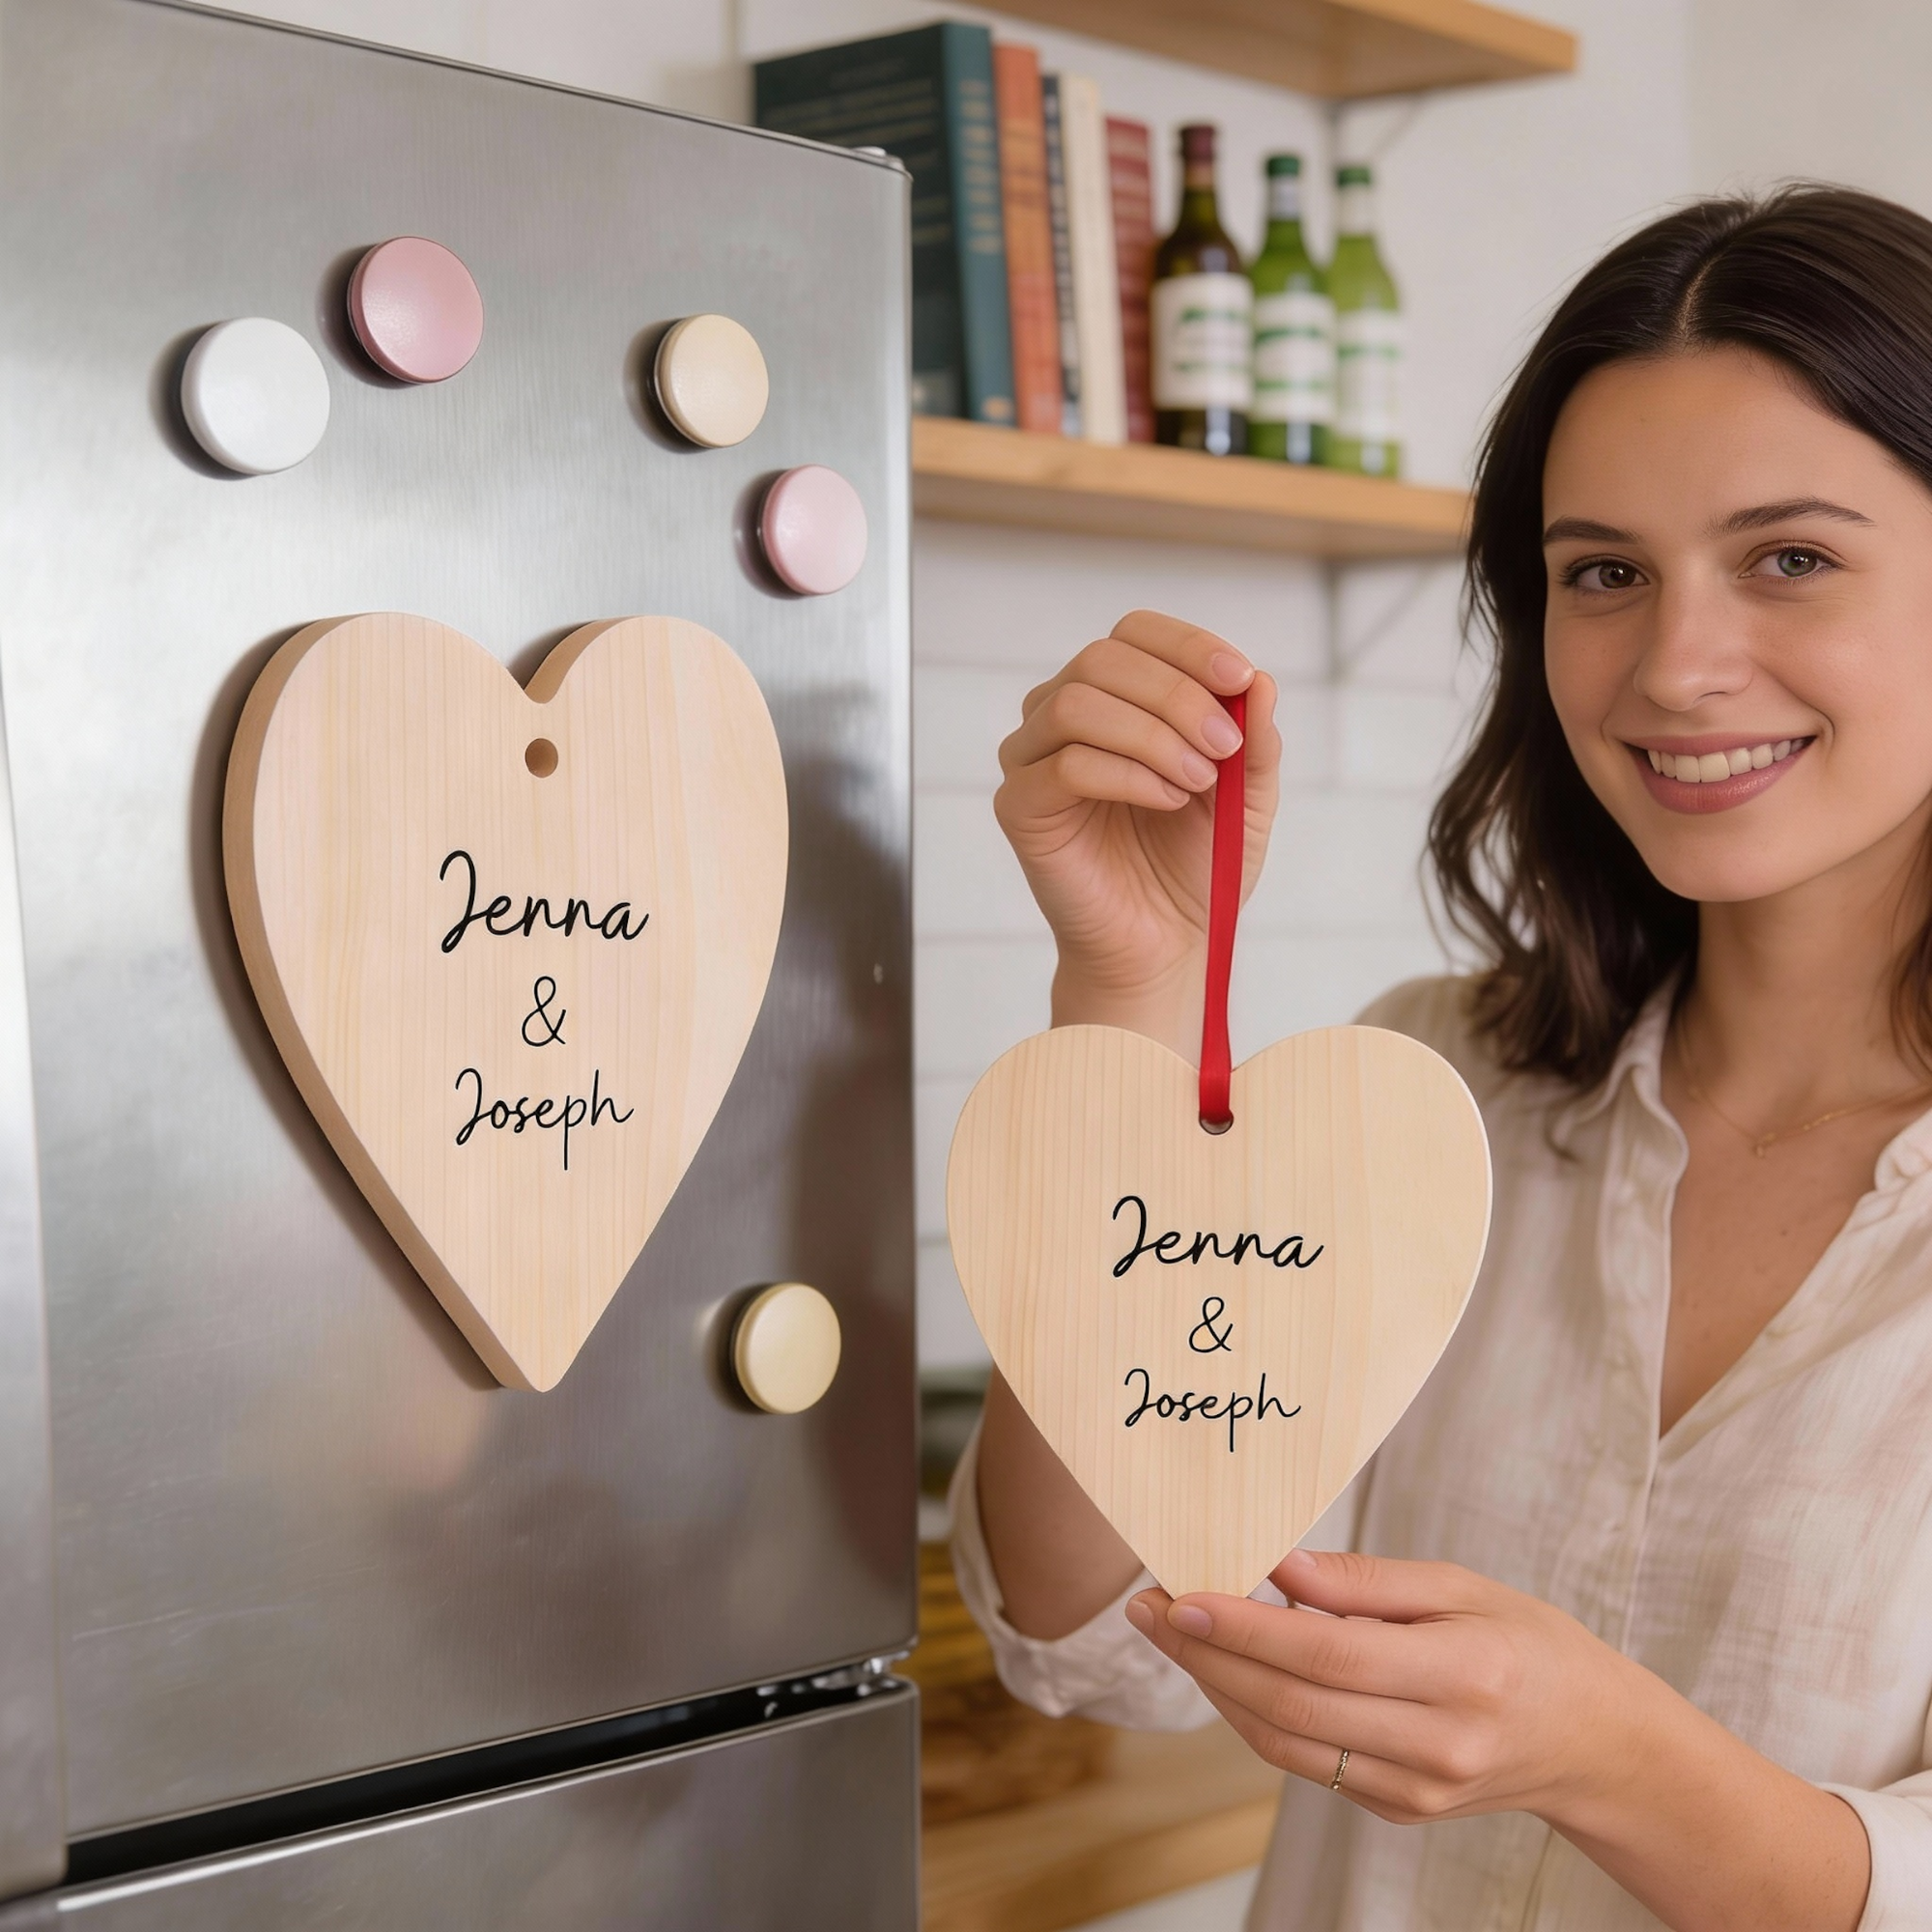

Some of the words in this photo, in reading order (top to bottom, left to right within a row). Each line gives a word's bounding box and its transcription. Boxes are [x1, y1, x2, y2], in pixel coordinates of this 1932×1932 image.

[440, 849, 650, 953] Jenna
[521, 976, 567, 1047] &
[455, 1067, 635, 1171] Joseph
[1112, 1195, 1324, 1278] Jenna
[1188, 1296, 1234, 1353] &
[1123, 1368, 1302, 1453] Joseph
